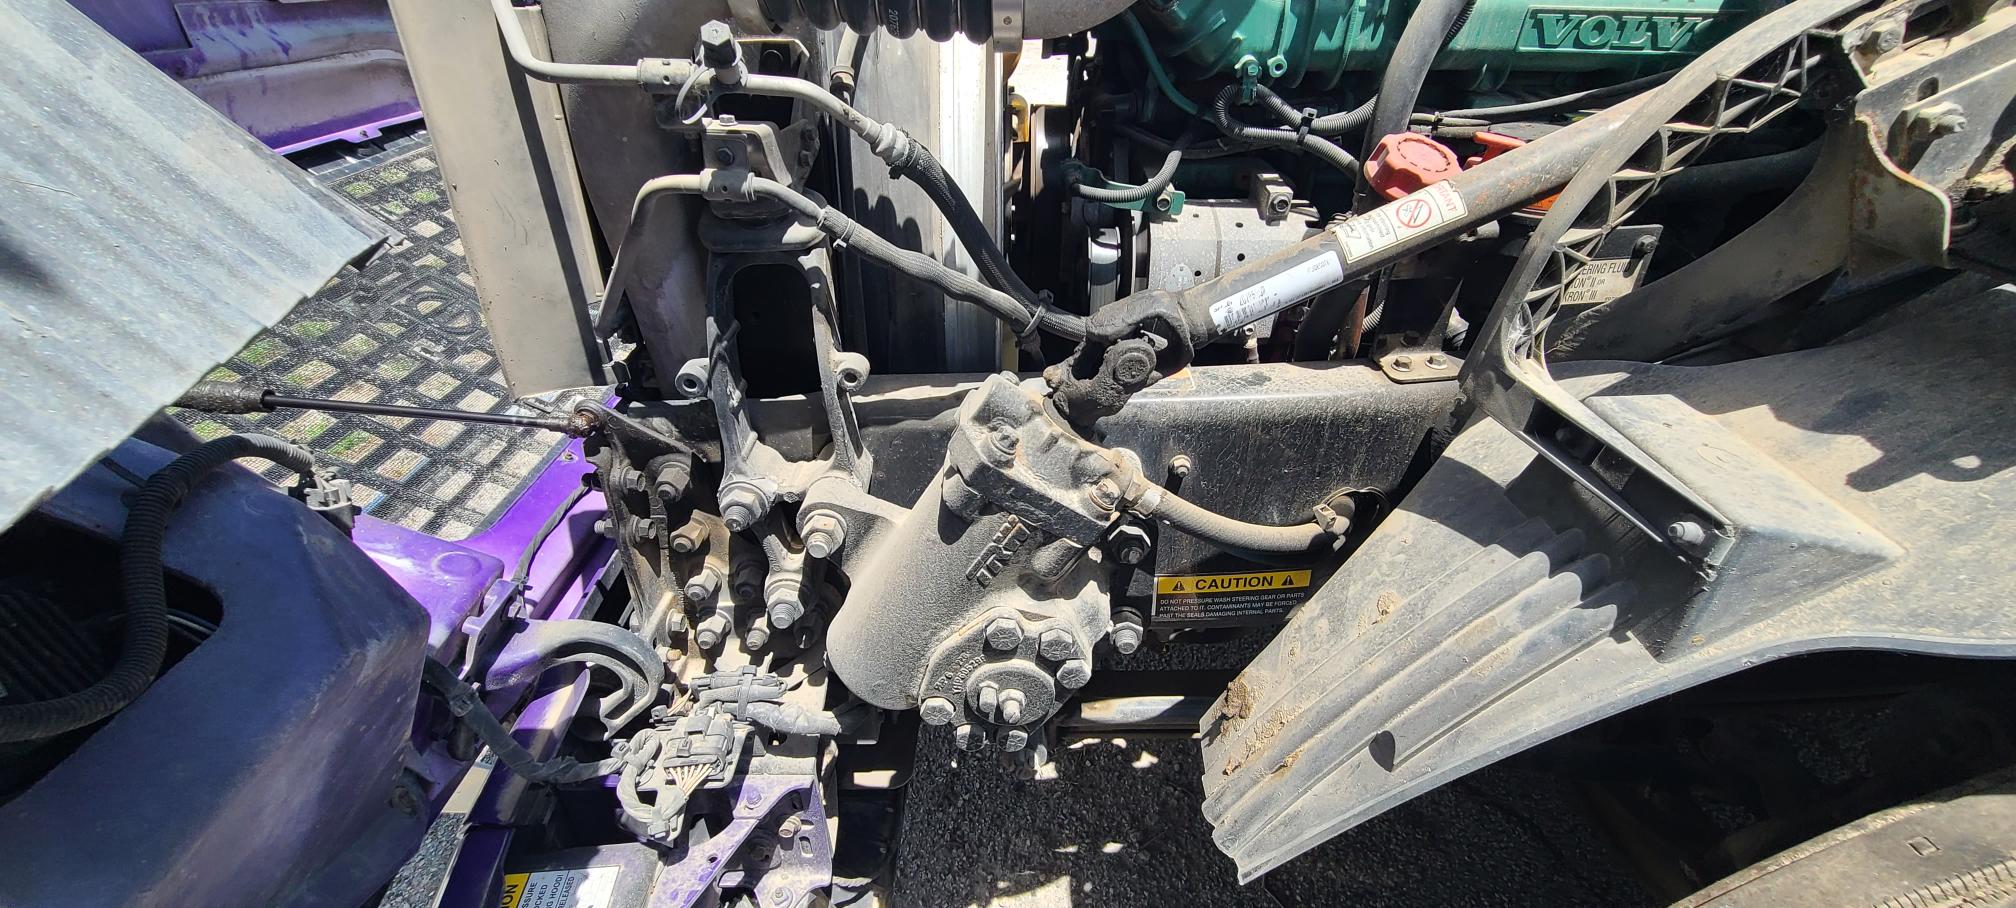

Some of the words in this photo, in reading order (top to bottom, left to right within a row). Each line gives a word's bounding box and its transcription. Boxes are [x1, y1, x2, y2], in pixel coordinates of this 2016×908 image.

[1533, 14, 1714, 49] VOLV
[966, 514, 1031, 589] TRW
[1195, 575, 1274, 590] CAUTION
[1207, 602, 1251, 610] CONTAMINANTS
[1274, 599, 1298, 607] FORCED
[1231, 594, 1260, 602] STEERING
[1205, 609, 1236, 617] DAMAGING
[1236, 608, 1264, 616] INTERNAL
